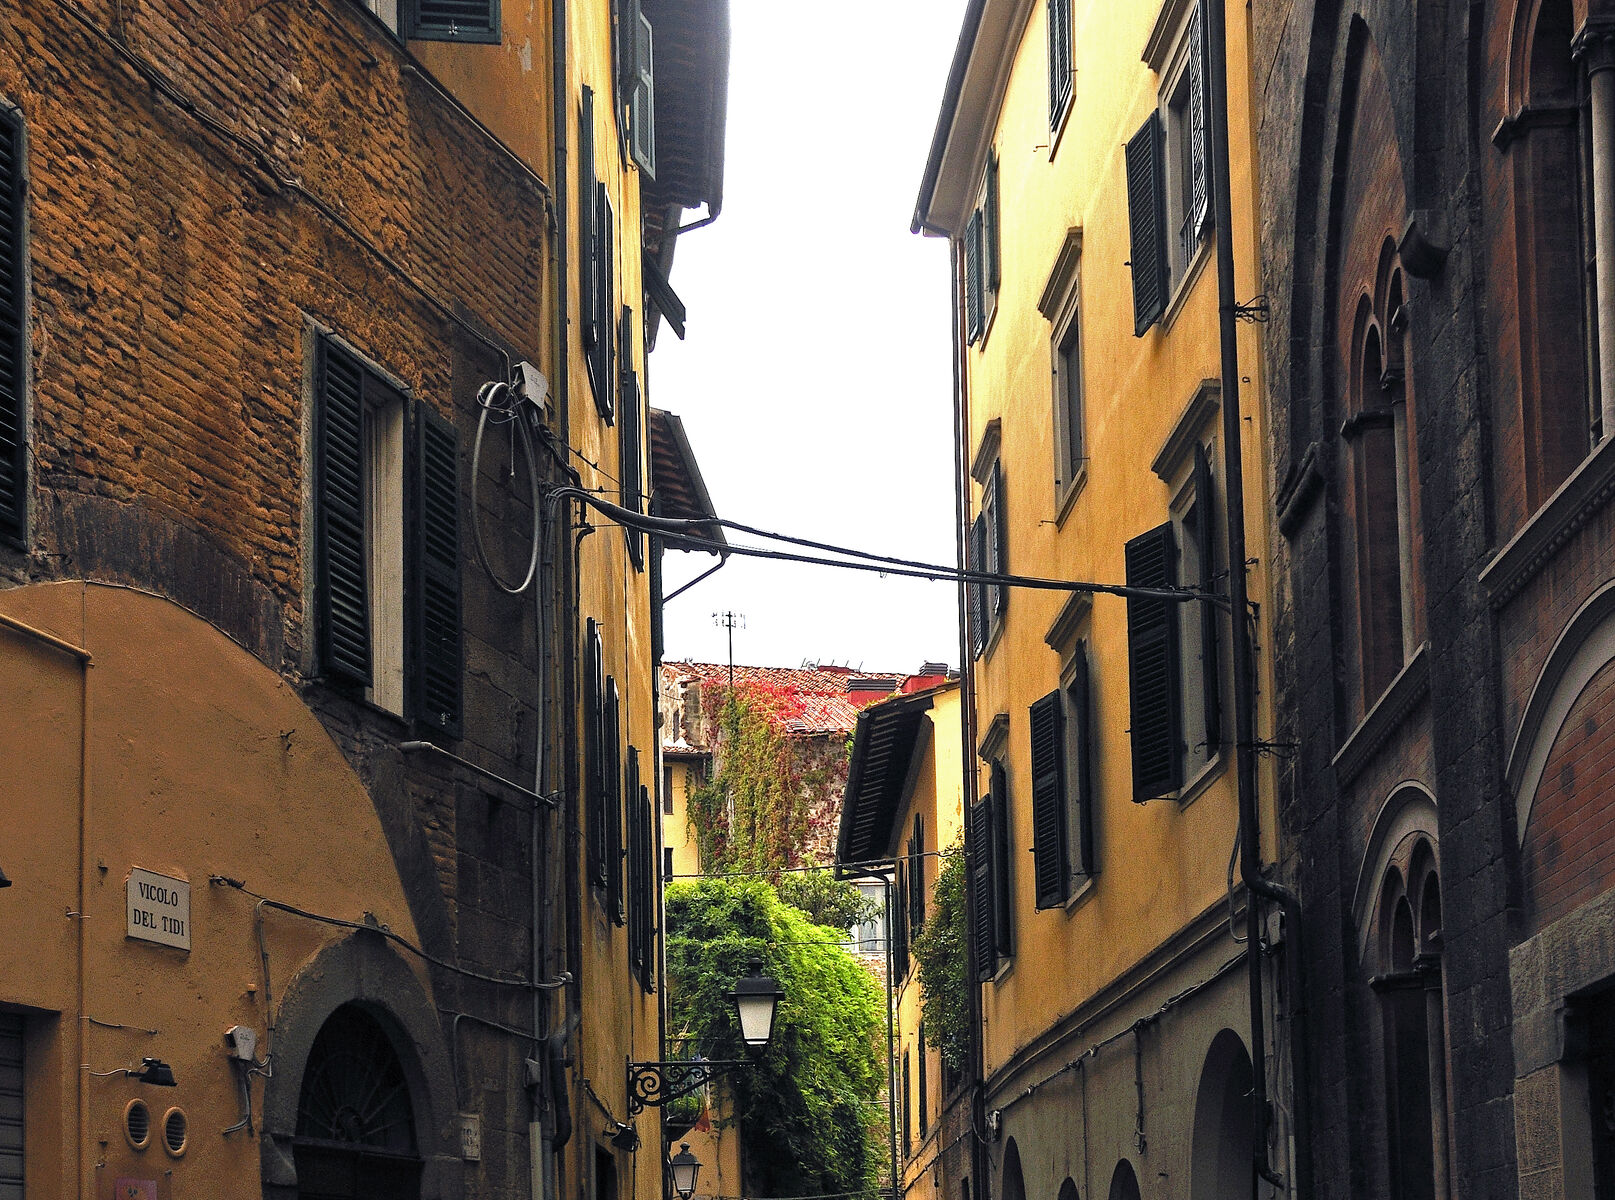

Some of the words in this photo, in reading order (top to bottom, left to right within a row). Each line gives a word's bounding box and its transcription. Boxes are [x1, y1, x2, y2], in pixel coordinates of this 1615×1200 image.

[138, 882, 178, 907] VICOLO
[133, 908, 157, 929] DEL
[161, 915, 185, 937] TIDI
